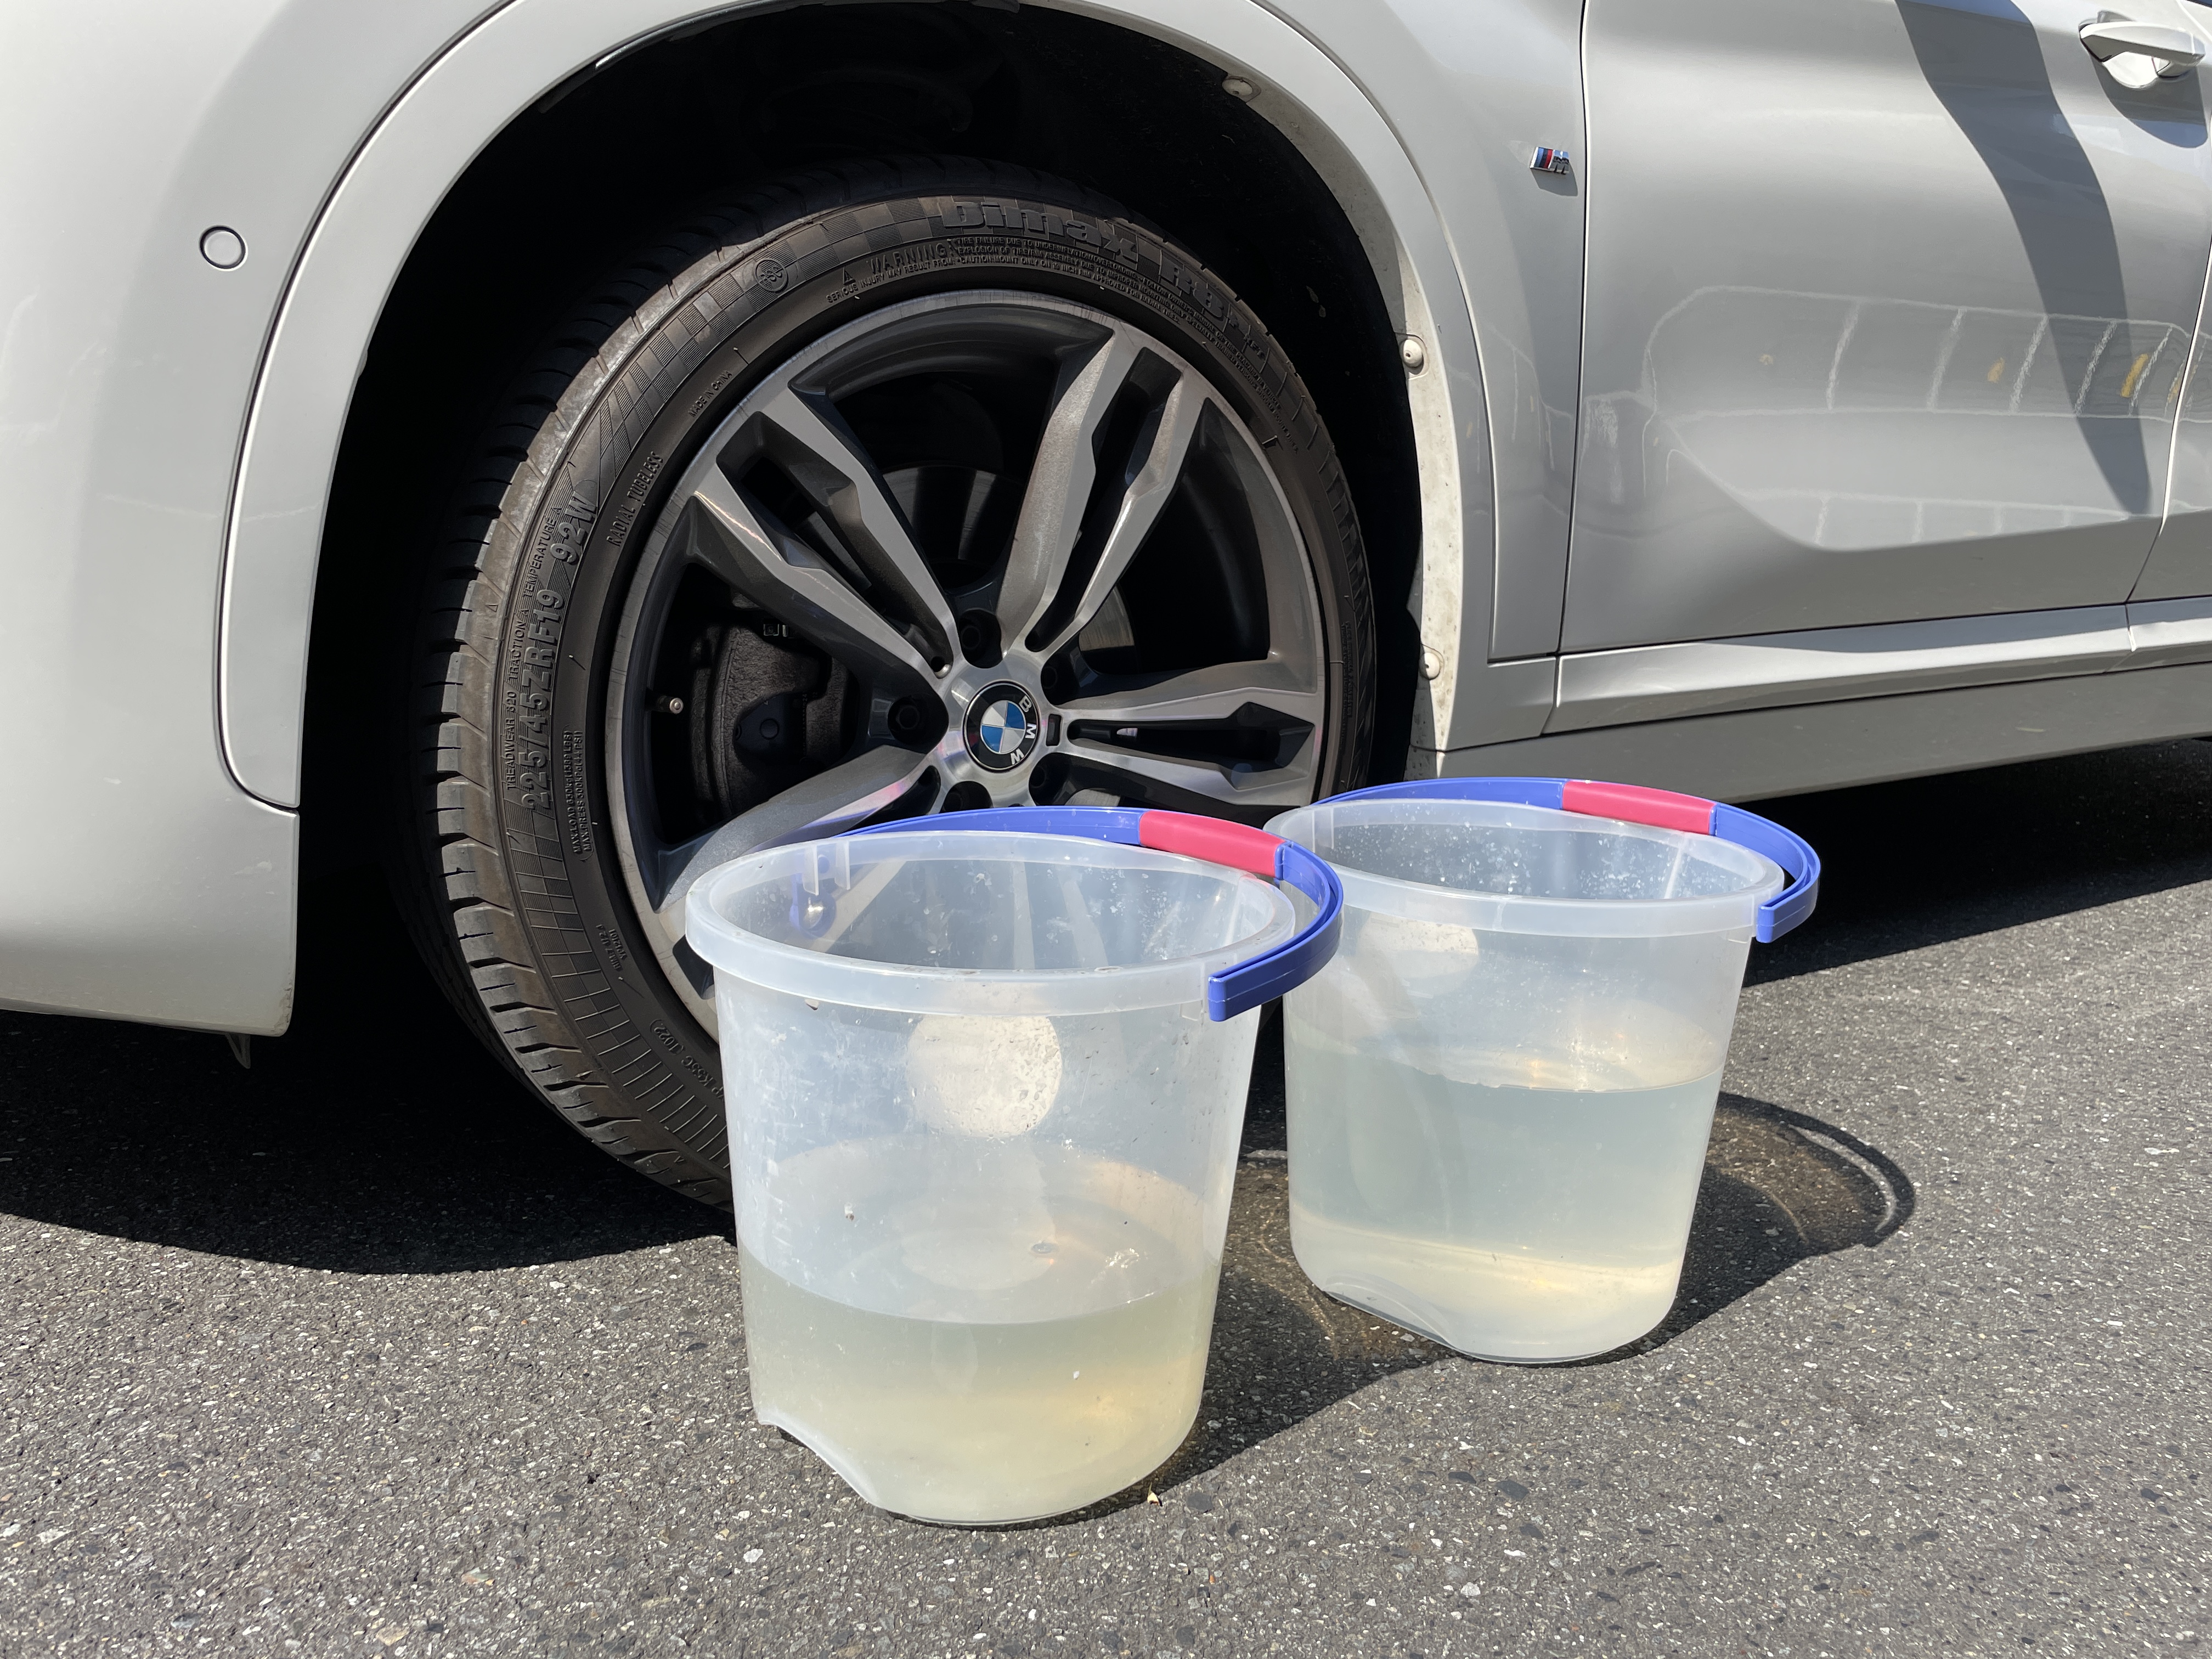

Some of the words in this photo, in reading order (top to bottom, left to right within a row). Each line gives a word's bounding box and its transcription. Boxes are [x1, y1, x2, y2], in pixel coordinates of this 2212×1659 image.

[957, 236, 974, 245] TIRE
[974, 236, 1005, 244] FAILURE
[1006, 237, 1021, 246] DUE
[1023, 239, 1032, 247] TO
[957, 245, 998, 255] EXPLOSION
[998, 246, 1011, 255] OF
[1045, 251, 1080, 266] ASSEMBLY
[1081, 260, 1093, 271] DUE
[1096, 264, 1104, 275] TO
[826, 283, 859, 303] SERIOUS
[860, 272, 884, 287] INJURY
[887, 267, 902, 279] MAY
[903, 262, 930, 274] RESULT
[1021, 257, 1038, 266] ONLY
[1040, 259, 1051, 268] ON
[687, 396, 707, 418] MADE
[707, 388, 715, 399] IN
[711, 370, 732, 391] CHINA
[551, 505, 563, 515] A
[606, 505, 636, 547] RADIAL
[627, 451, 664, 503] TUBELESS
[550, 490, 597, 563] 92W
[522, 517, 557, 597] TEMPERATURE
[519, 607, 530, 616] A
[508, 619, 527, 680] TRACTION
[504, 717, 516, 790] TREADWEAR
[1010, 695, 1037, 765] BMW
